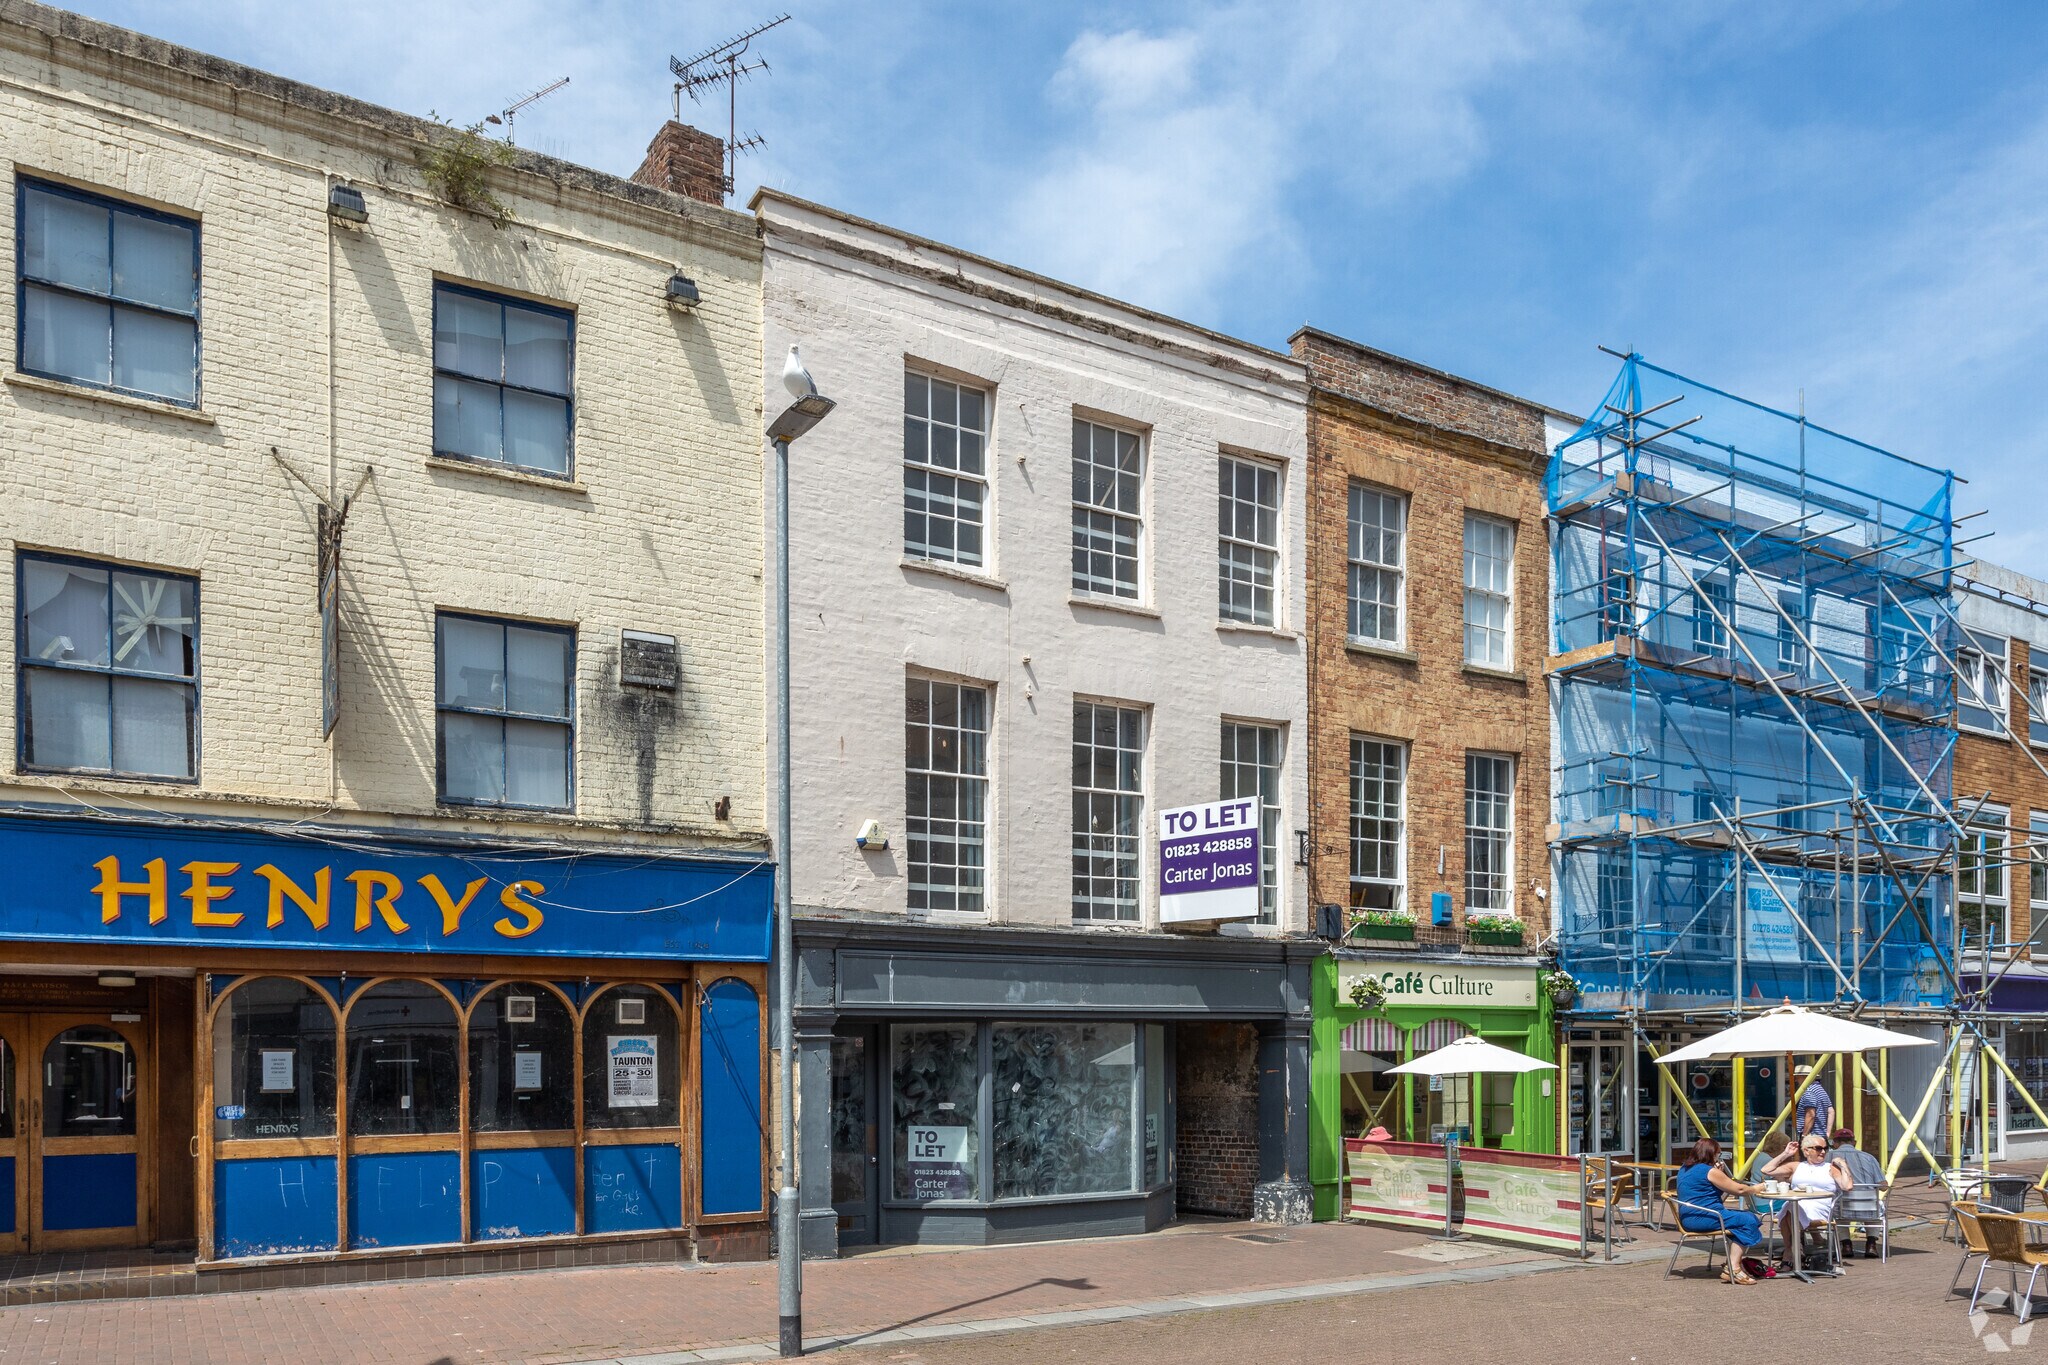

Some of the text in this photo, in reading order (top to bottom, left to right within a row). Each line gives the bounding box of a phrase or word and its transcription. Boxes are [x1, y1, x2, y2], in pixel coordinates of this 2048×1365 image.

[1165, 803, 1251, 834] TO LET
[1165, 837, 1252, 858] 01823 428858
[1165, 862, 1252, 884] Carter Jonas
[90, 854, 545, 939] HENRYS
[1381, 971, 1493, 996] Café Culture
[613, 1057, 653, 1066] TAUNTON
[256, 1123, 299, 1134] HENRYS
[915, 1131, 938, 1144] TO
[915, 1145, 946, 1157] LET
[915, 1178, 948, 1189] Carter
[1383, 1167, 1413, 1184] Café
[916, 1188, 945, 1200] Jonas
[1376, 1181, 1422, 1200] Culture
[1503, 1180, 1538, 1197] Café
[1494, 1193, 1550, 1216] Culture
